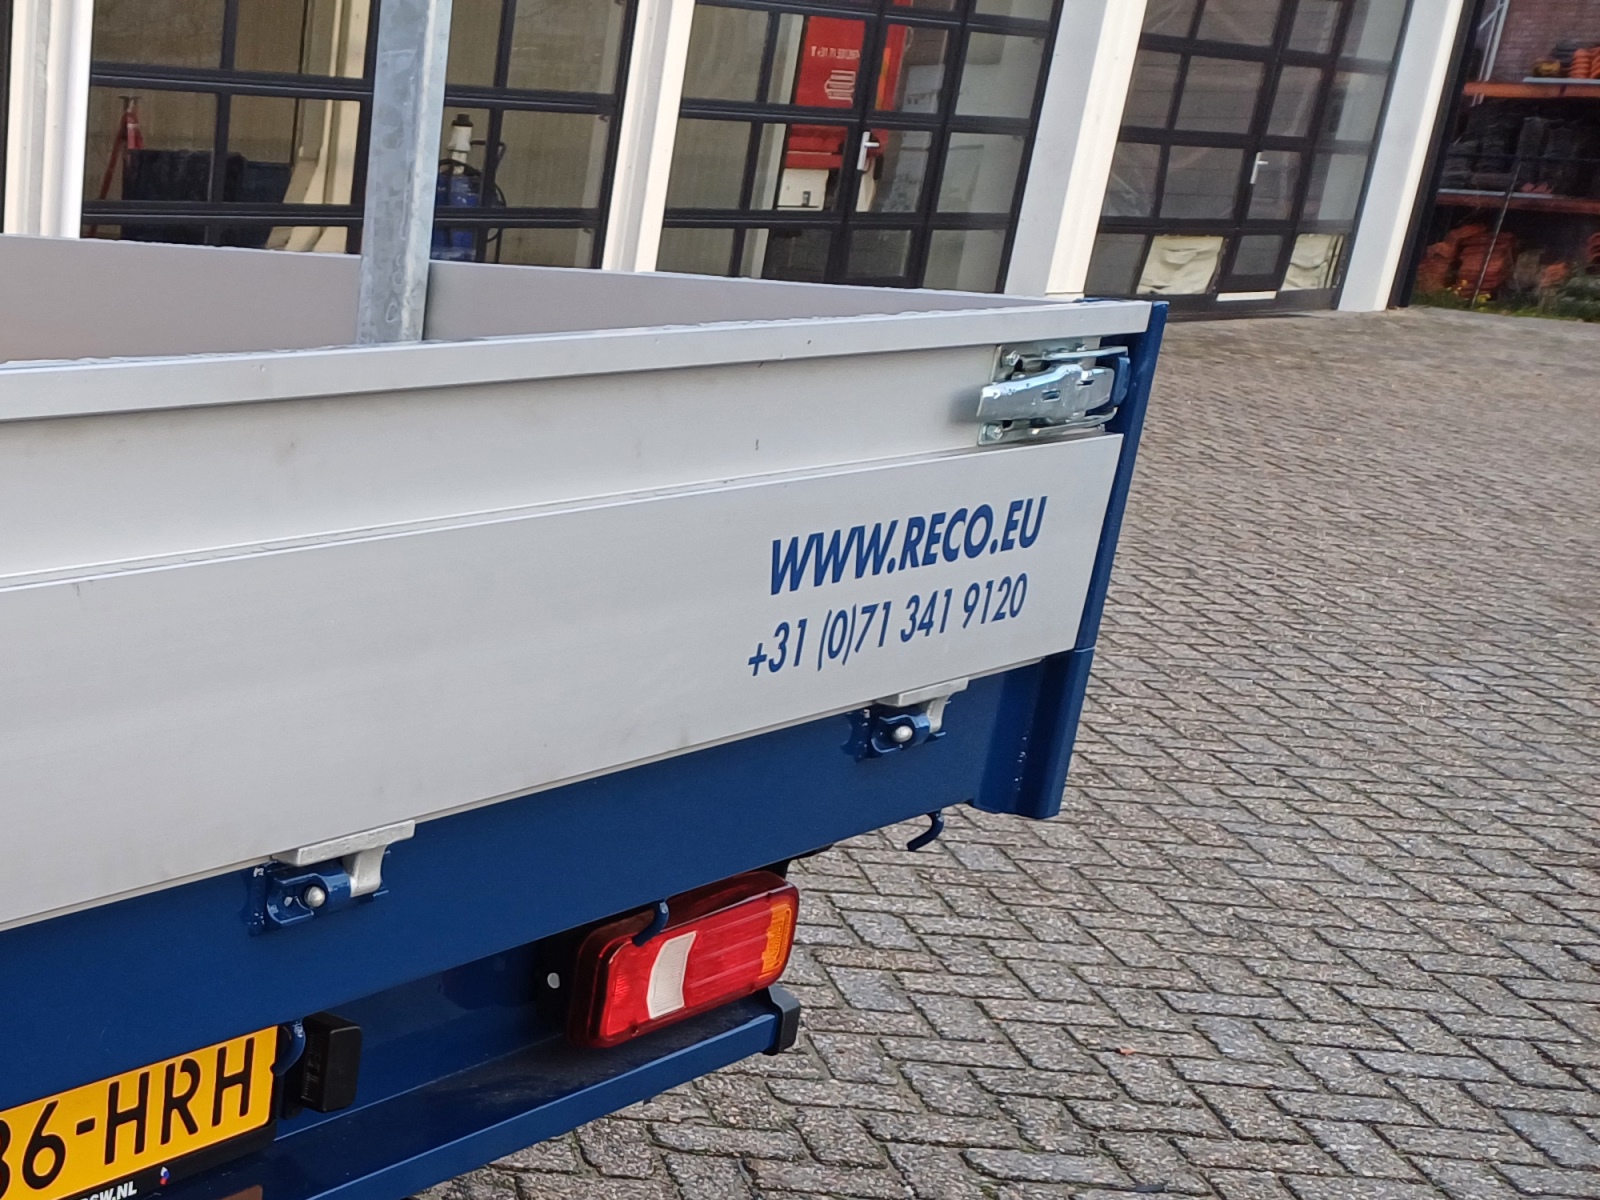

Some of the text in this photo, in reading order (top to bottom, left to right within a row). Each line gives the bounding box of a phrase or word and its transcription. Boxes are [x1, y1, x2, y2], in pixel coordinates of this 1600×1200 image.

[770, 495, 1048, 596] WWW.RECO.EU
[748, 573, 1028, 677] +31 (0)71 341 9120
